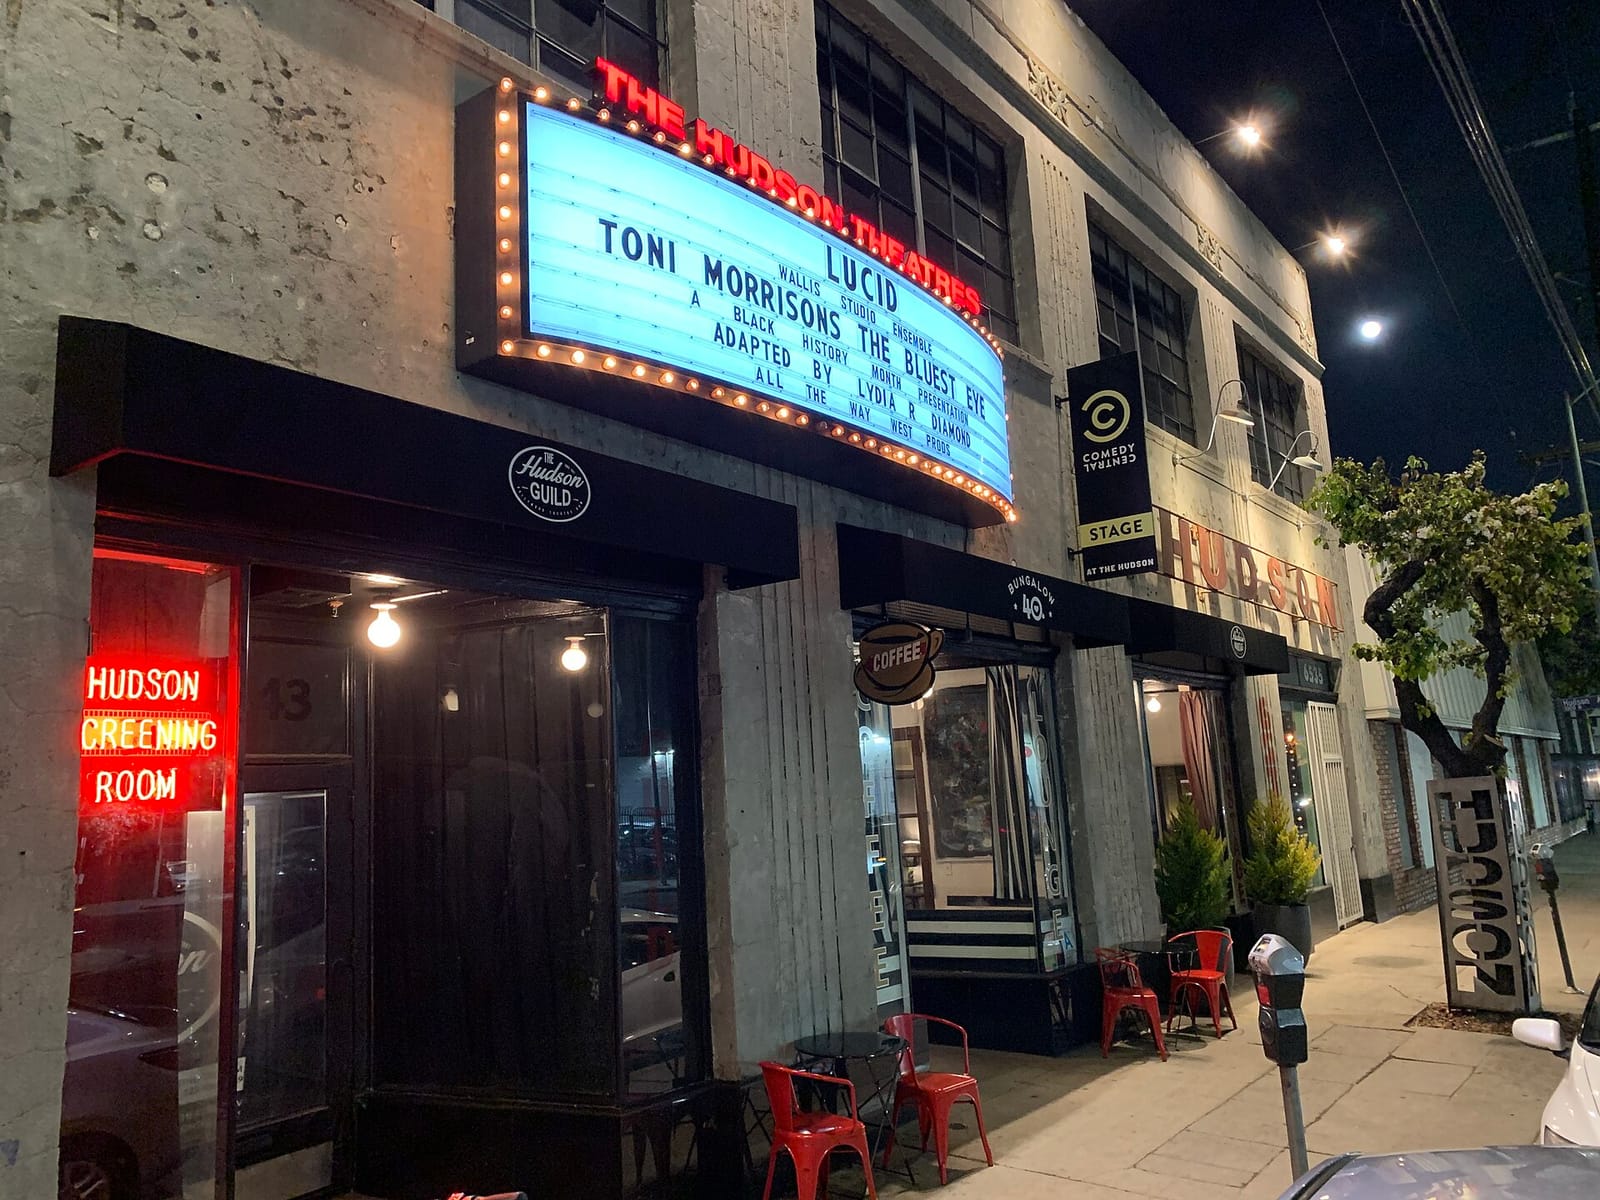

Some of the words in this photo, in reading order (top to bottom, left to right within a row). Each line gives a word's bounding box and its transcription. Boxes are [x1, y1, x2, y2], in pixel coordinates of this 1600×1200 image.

[596, 56, 686, 141] THE
[694, 118, 844, 231] HUDSON
[850, 213, 981, 316] THEATRES
[826, 245, 898, 313] LUCID
[598, 217, 676, 273] TONI
[703, 253, 841, 340] MORRISONS
[858, 324, 891, 364] THE
[905, 347, 956, 399] BLUEST
[966, 385, 986, 420] EYE
[779, 263, 821, 297] WALLIS
[841, 295, 876, 324] STUDIO
[893, 322, 933, 357] ENSEMBLE
[691, 289, 701, 308] A
[733, 305, 775, 336] BLACK
[802, 333, 848, 367] HISTORY
[871, 364, 902, 391] MONTH
[918, 387, 969, 426] PRESENTATION
[713, 322, 791, 368] ADAPTED
[813, 359, 832, 385] BY
[858, 377, 897, 412] LYDIA
[908, 401, 917, 421] R
[931, 413, 971, 448] DIAMOND
[755, 366, 784, 390] ALL
[806, 384, 827, 405] THE
[850, 400, 871, 422] WAY
[890, 417, 913, 440] WEST
[926, 433, 951, 458] PRODS
[543, 451, 555, 465] THE
[1082, 442, 1136, 464] COMEDY
[1083, 453, 1137, 473] CENTRAL
[515, 454, 585, 489] Hudson
[530, 481, 572, 507] GUILD
[1089, 519, 1144, 541] STAGE
[1086, 567, 1098, 576] AT
[1099, 564, 1116, 574] THE
[1118, 558, 1155, 571] HUDSON
[1159, 506, 1338, 629] HUDSON
[1007, 575, 1055, 606] BUNGALOW
[1022, 593, 1043, 622] 40
[873, 641, 921, 673] COFFEE
[87, 666, 201, 702] HUDSON
[81, 718, 218, 751] CREENING
[94, 768, 178, 804] ROOM
